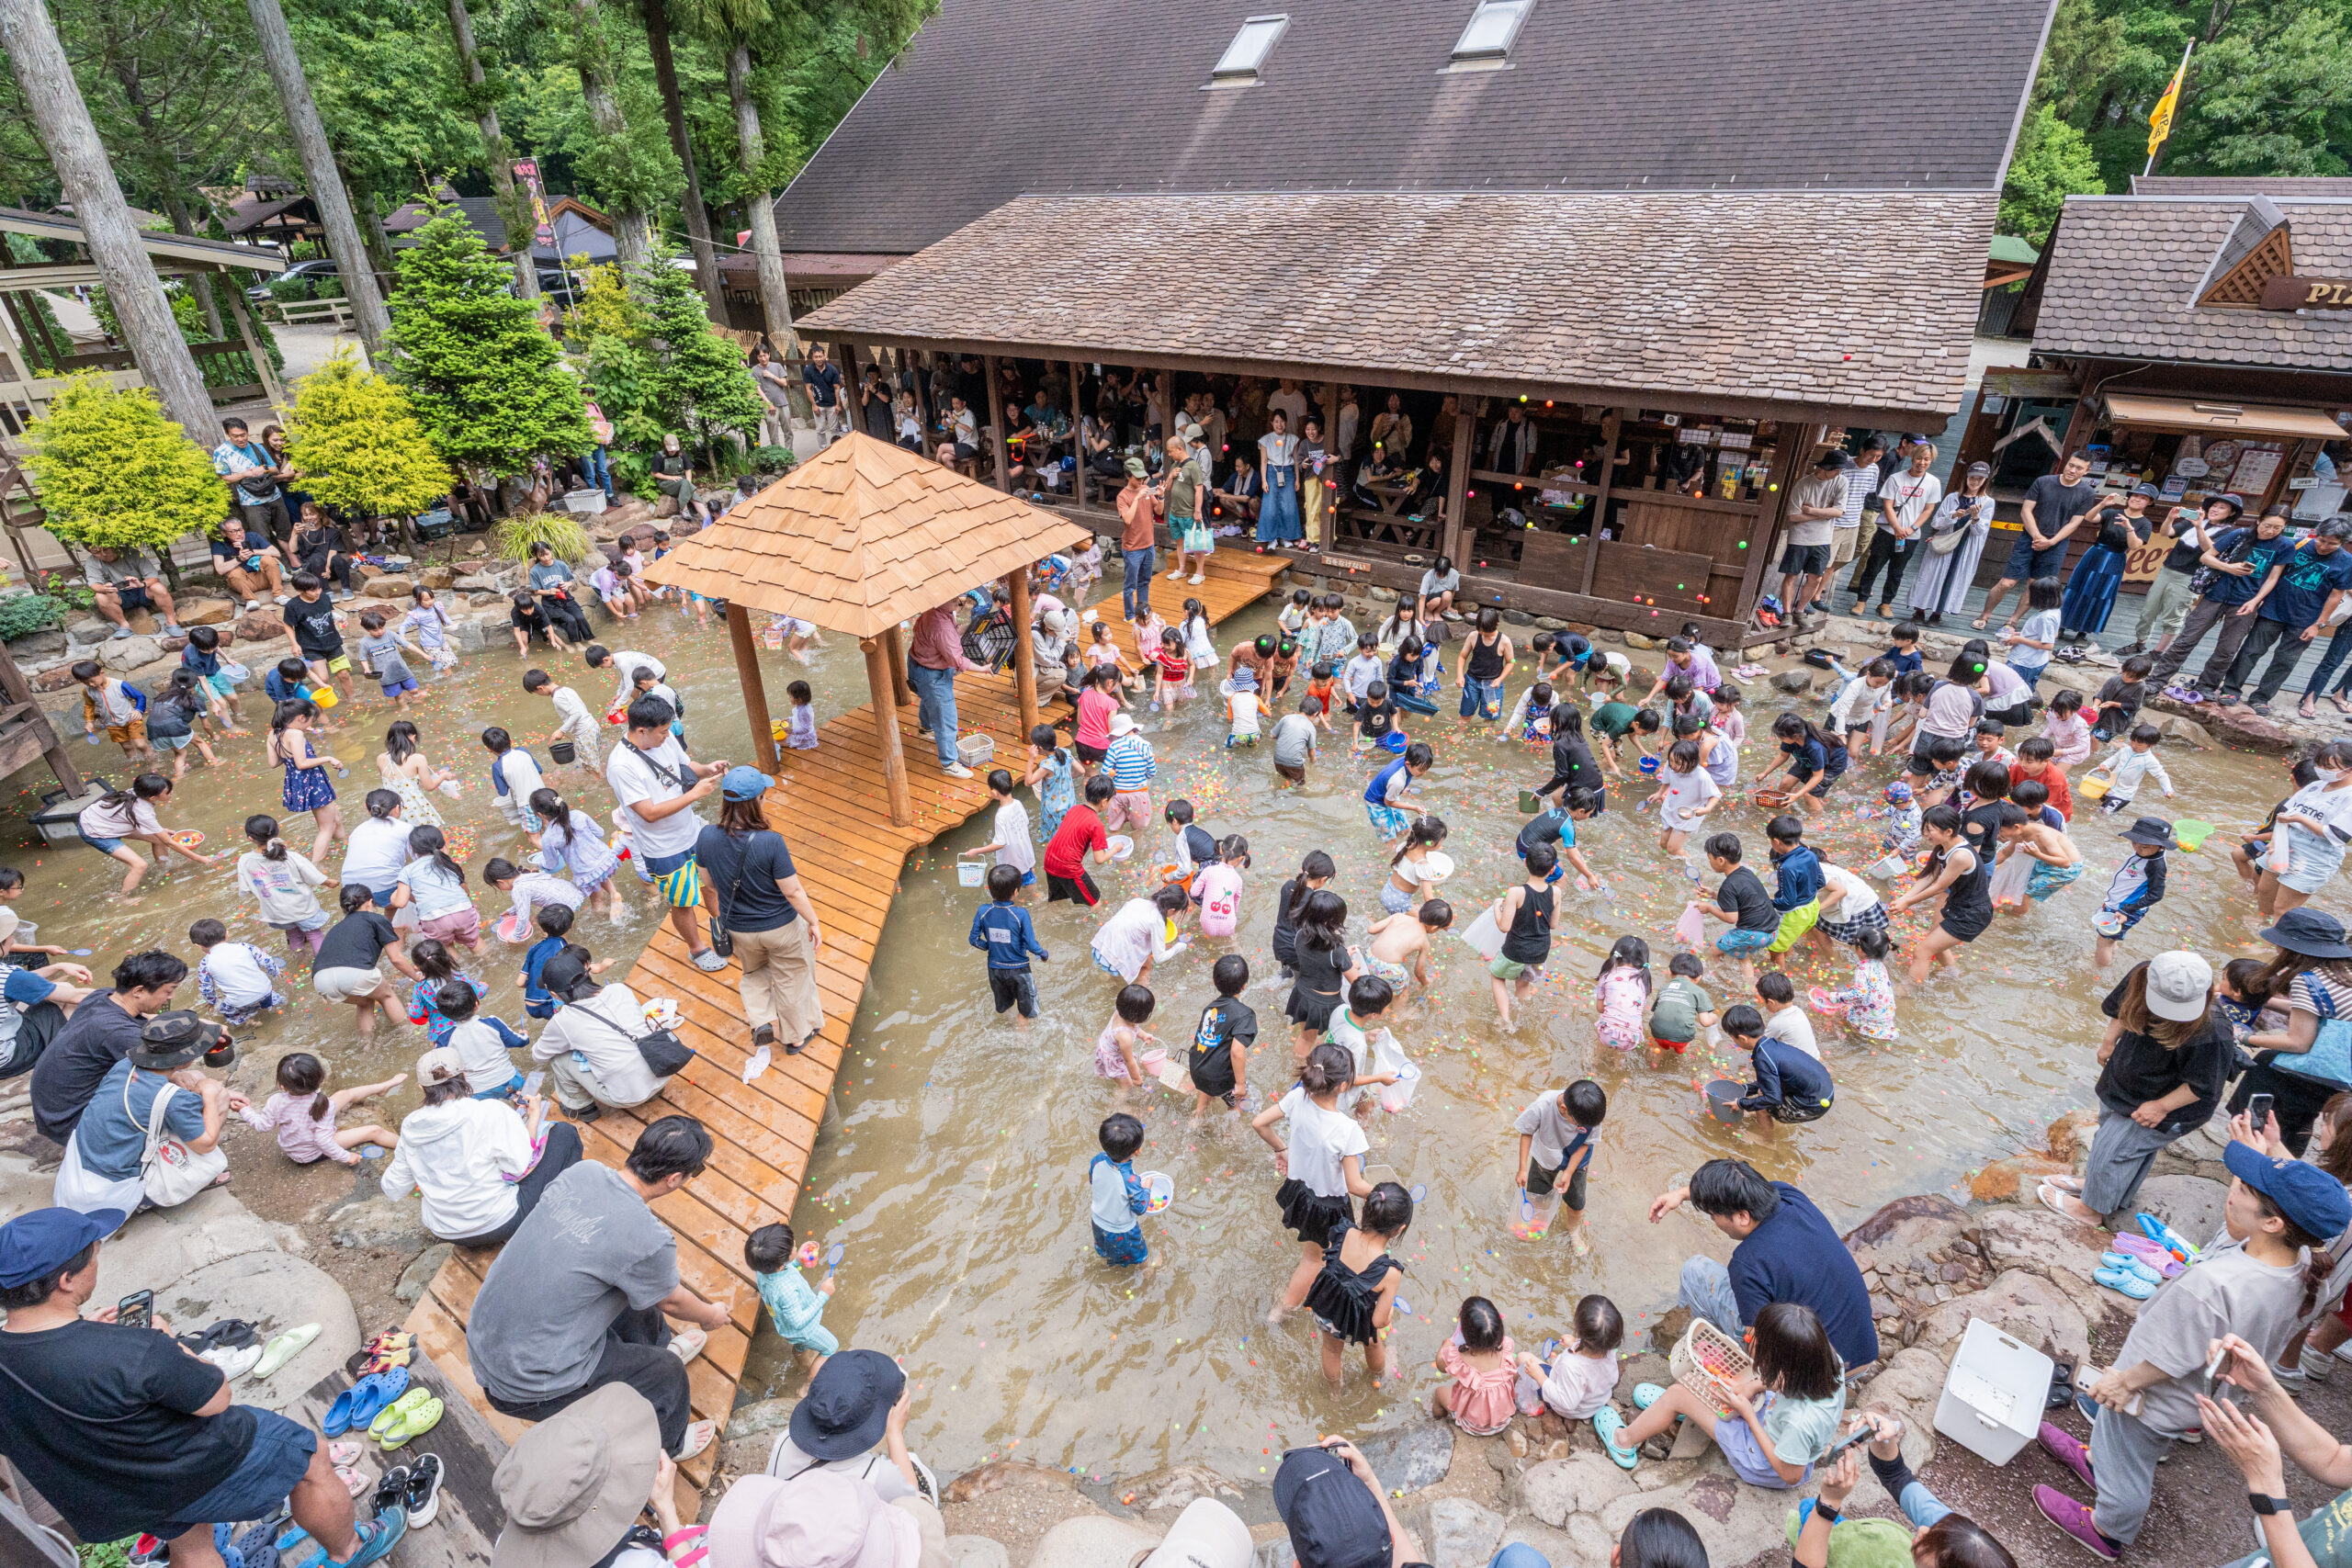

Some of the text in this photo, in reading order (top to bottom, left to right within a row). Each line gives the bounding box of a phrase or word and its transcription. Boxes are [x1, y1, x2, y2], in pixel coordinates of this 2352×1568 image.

[1326, 558, 1366, 570] 石をなげない
[2125, 547, 2174, 574] ee
[371, 647, 395, 657] patagonia
